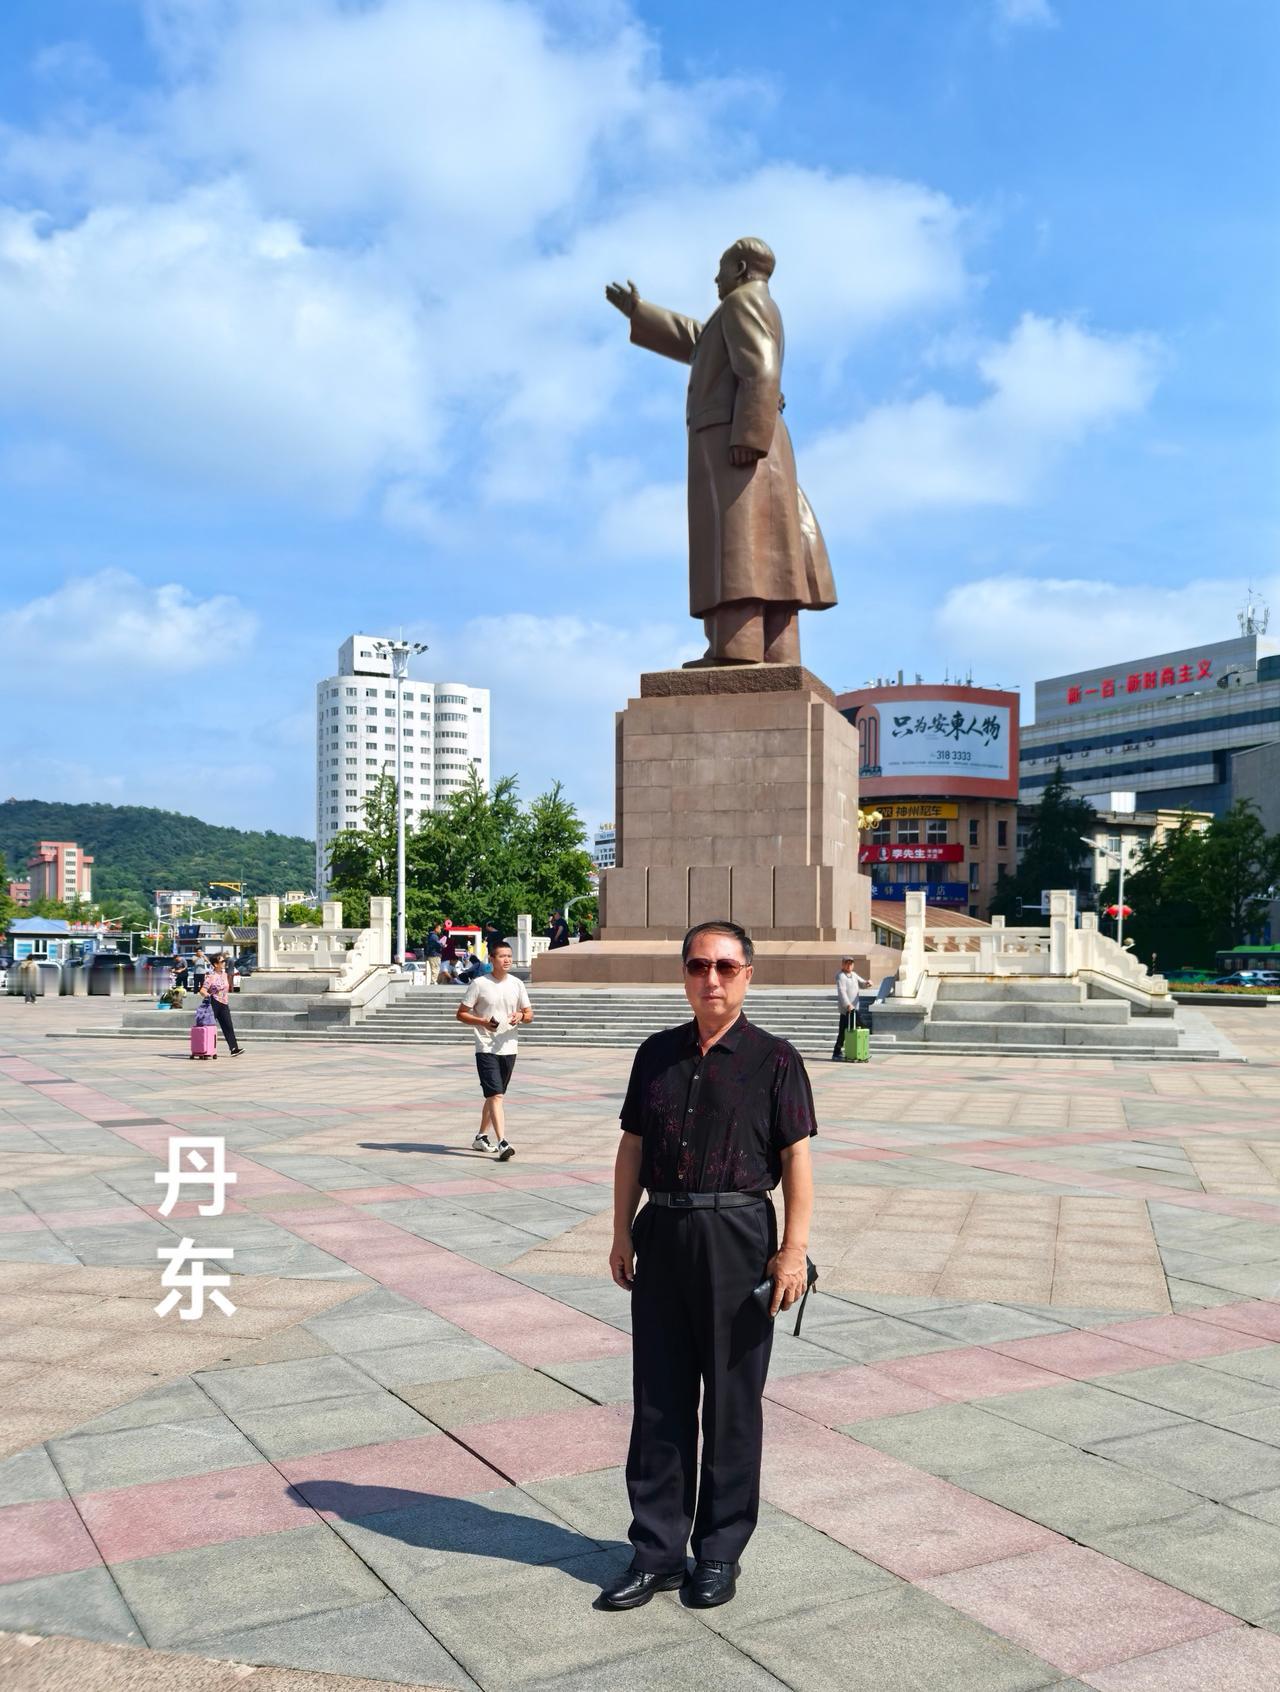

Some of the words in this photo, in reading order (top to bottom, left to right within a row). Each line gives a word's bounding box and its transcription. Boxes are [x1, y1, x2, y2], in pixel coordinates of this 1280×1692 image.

[936, 750, 950, 760] 318
[952, 751, 971, 761] 3333
[892, 848, 925, 859] 李先生
